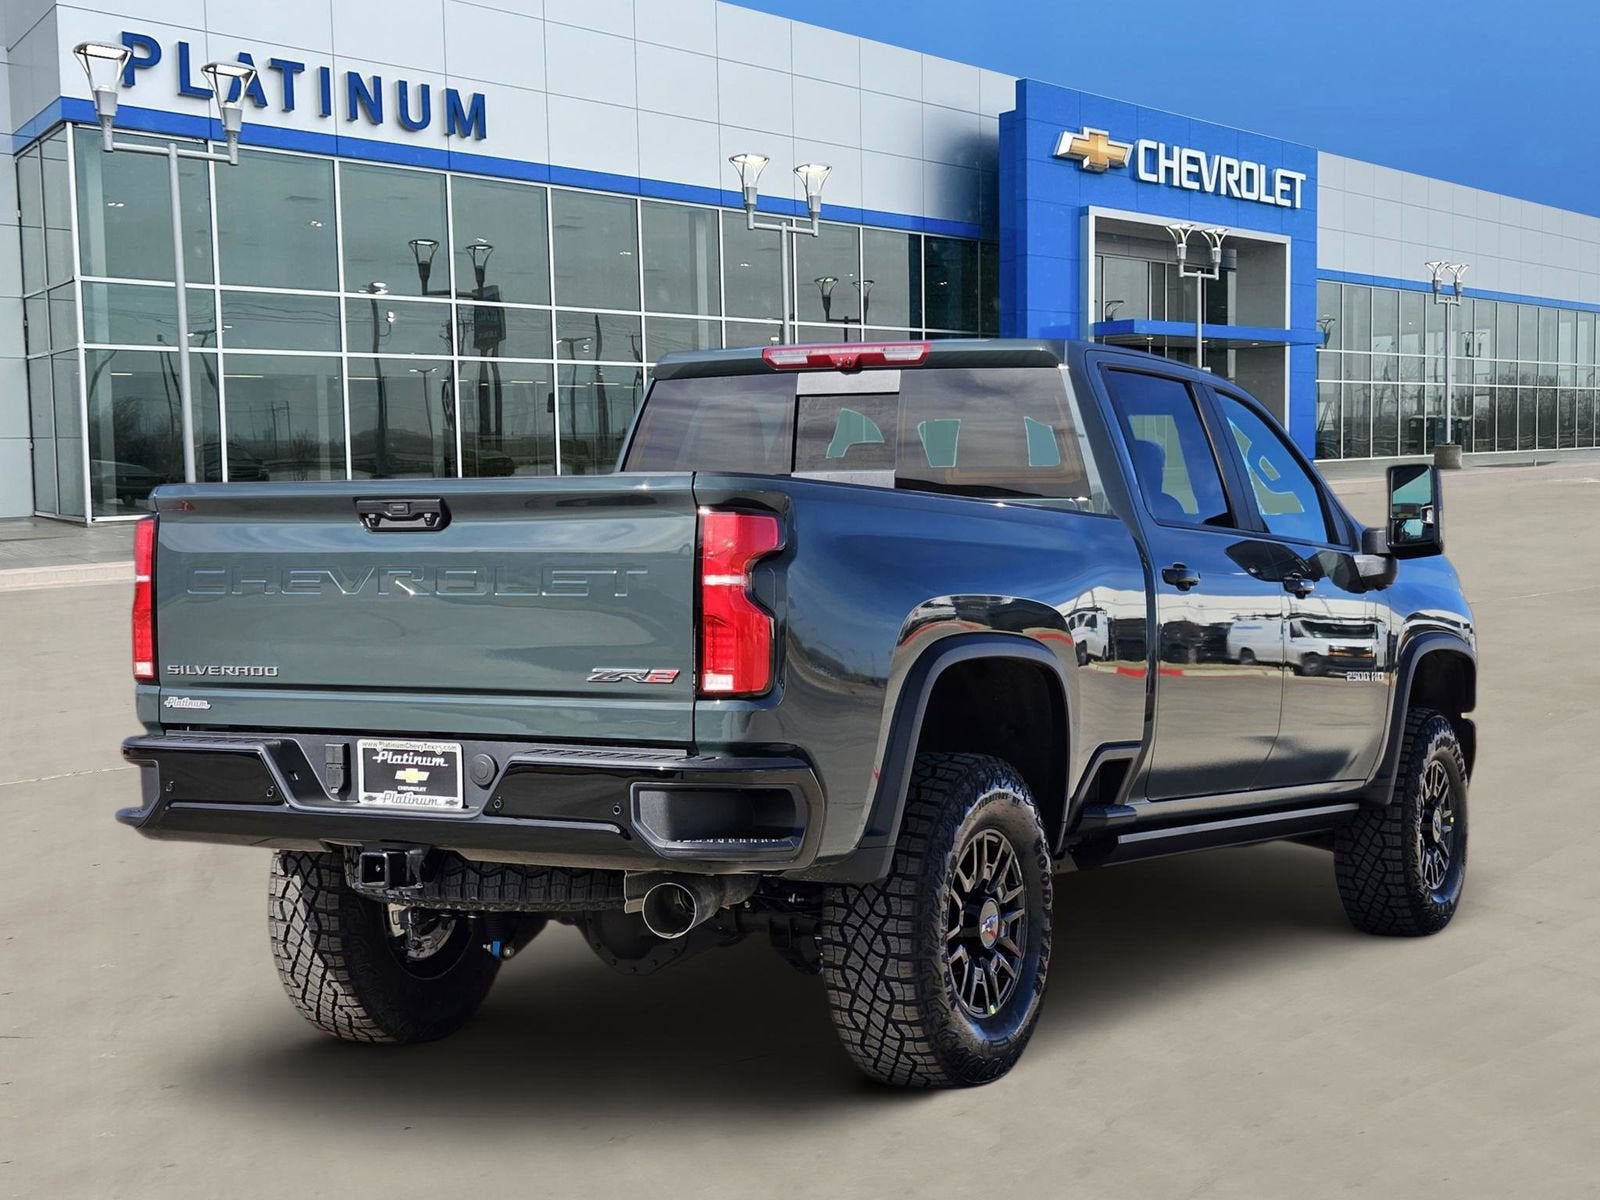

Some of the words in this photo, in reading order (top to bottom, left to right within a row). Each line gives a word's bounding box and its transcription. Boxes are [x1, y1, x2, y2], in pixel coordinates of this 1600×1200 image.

[121, 31, 487, 140] PLATINUM
[1136, 138, 1307, 209] CHEVROLET
[186, 565, 649, 597] CHEVROLET
[167, 664, 279, 676] SILVERADO
[586, 668, 680, 684] ZR2
[164, 696, 211, 709] Platinum
[372, 750, 449, 767] Platinum
[380, 792, 441, 806] Platinum
